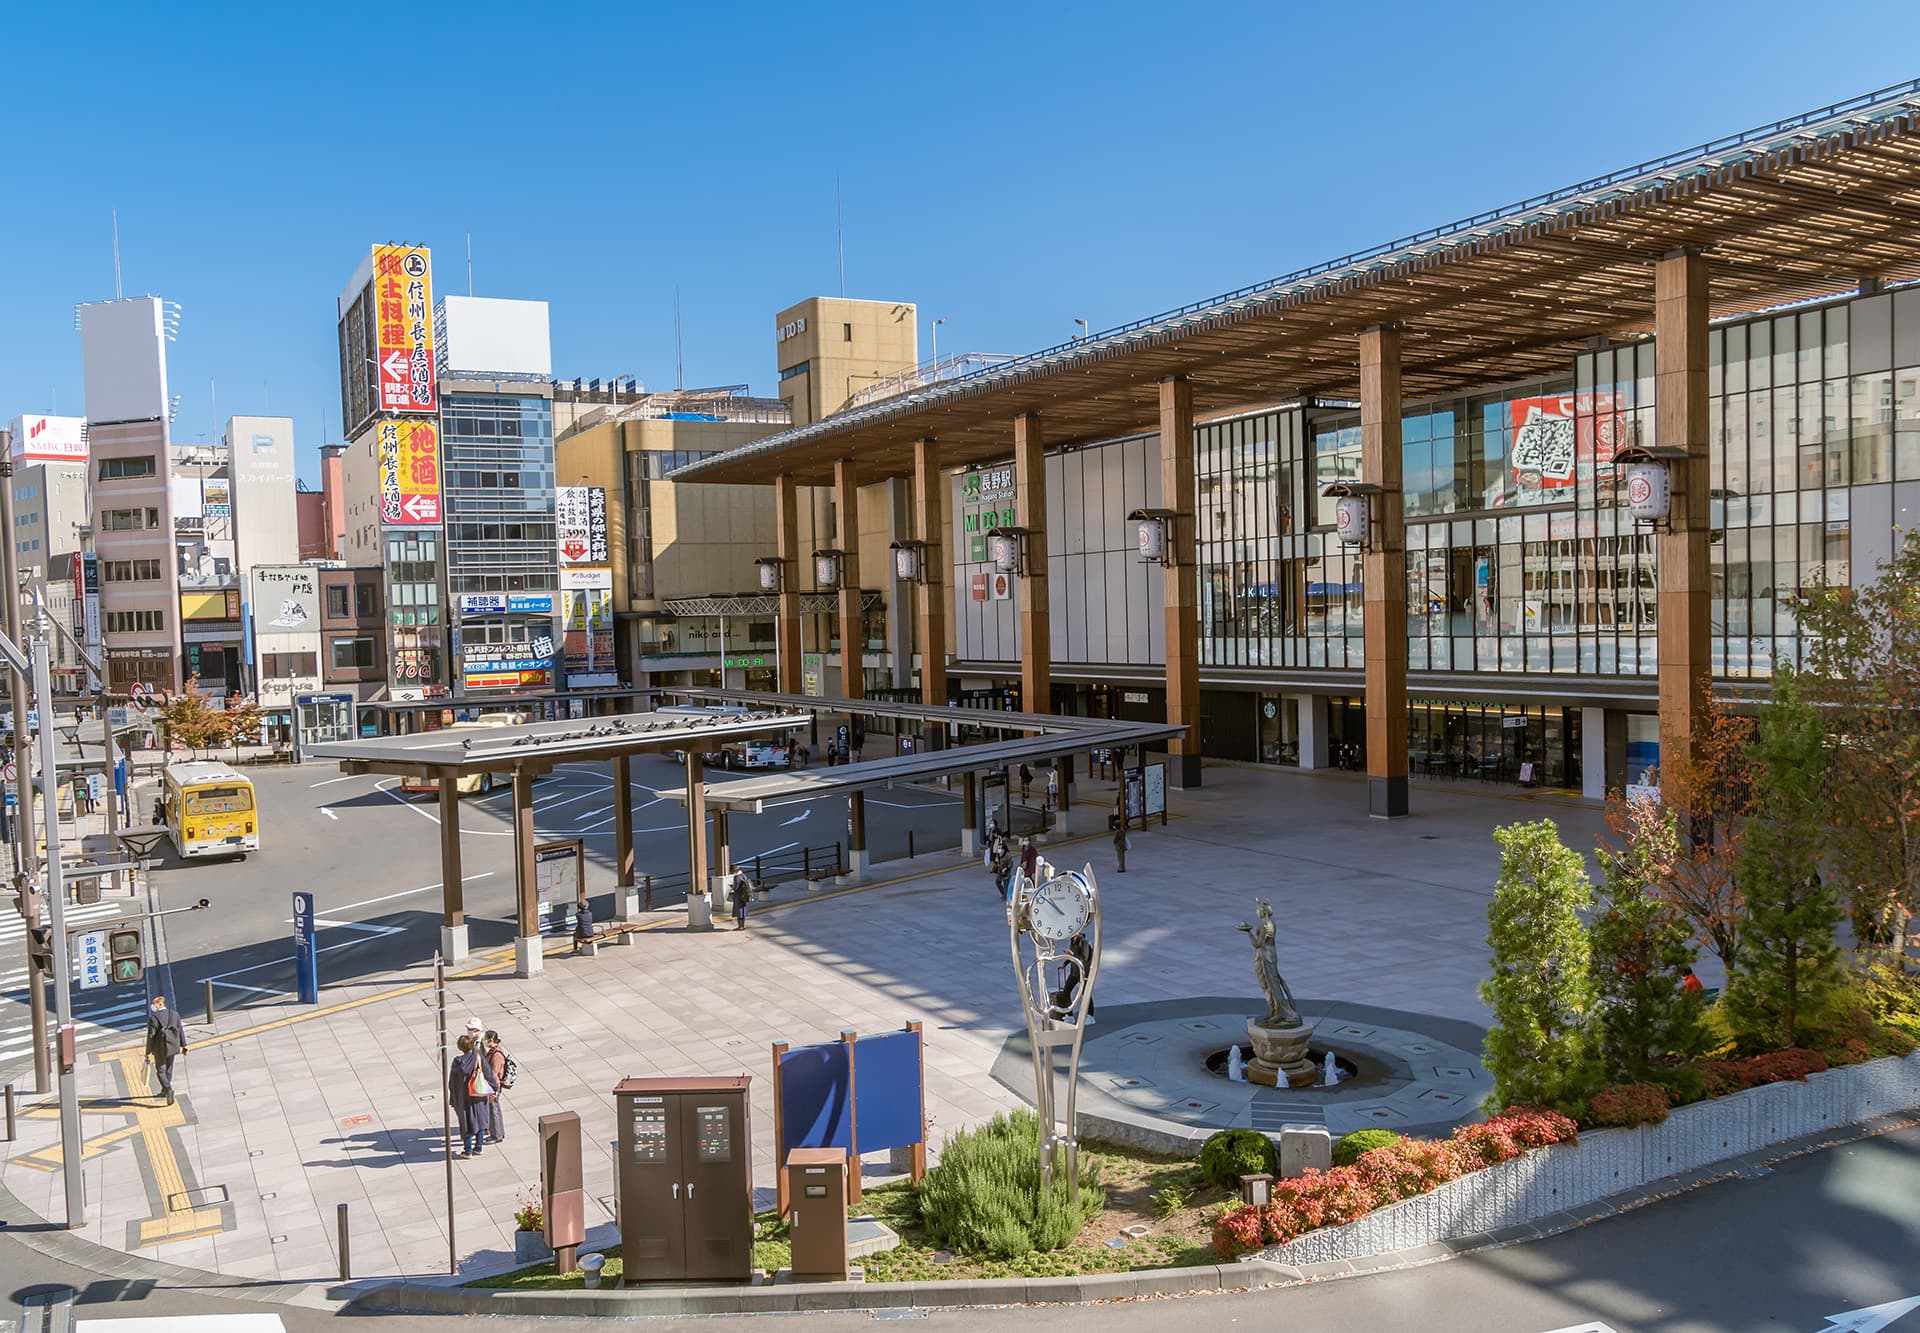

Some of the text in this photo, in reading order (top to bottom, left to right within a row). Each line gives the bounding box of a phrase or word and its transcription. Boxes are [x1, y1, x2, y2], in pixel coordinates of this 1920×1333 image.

[379, 254, 405, 345] 郷土料理
[408, 281, 430, 403] 信州長屋酒場
[30, 441, 60, 452] SMBC
[410, 425, 437, 485] 地酒
[382, 425, 402, 519] 信州長屋酒場
[982, 470, 1011, 490] 長野駅
[962, 475, 980, 497] JR
[567, 489, 577, 526] 飲み放題
[589, 488, 607, 561] 長野県の郷土料理
[965, 508, 1016, 532] MI DO RI
[579, 572, 600, 581] Budget
[467, 596, 499, 607] 補聴器
[689, 629, 710, 639] niko
[474, 644, 531, 654] 長野フォレスト歯科
[531, 636, 554, 659] 歯
[1054, 883, 1062, 891] 12
[1067, 885, 1070, 893] 1
[1033, 908, 1039, 916] 9
[1079, 904, 1084, 913] 3
[1037, 920, 1042, 928] 8
[1068, 925, 1073, 933] 5
[1046, 927, 1051, 935] 7
[1057, 929, 1062, 937] 6
[86, 936, 99, 985] 歩車分離式
